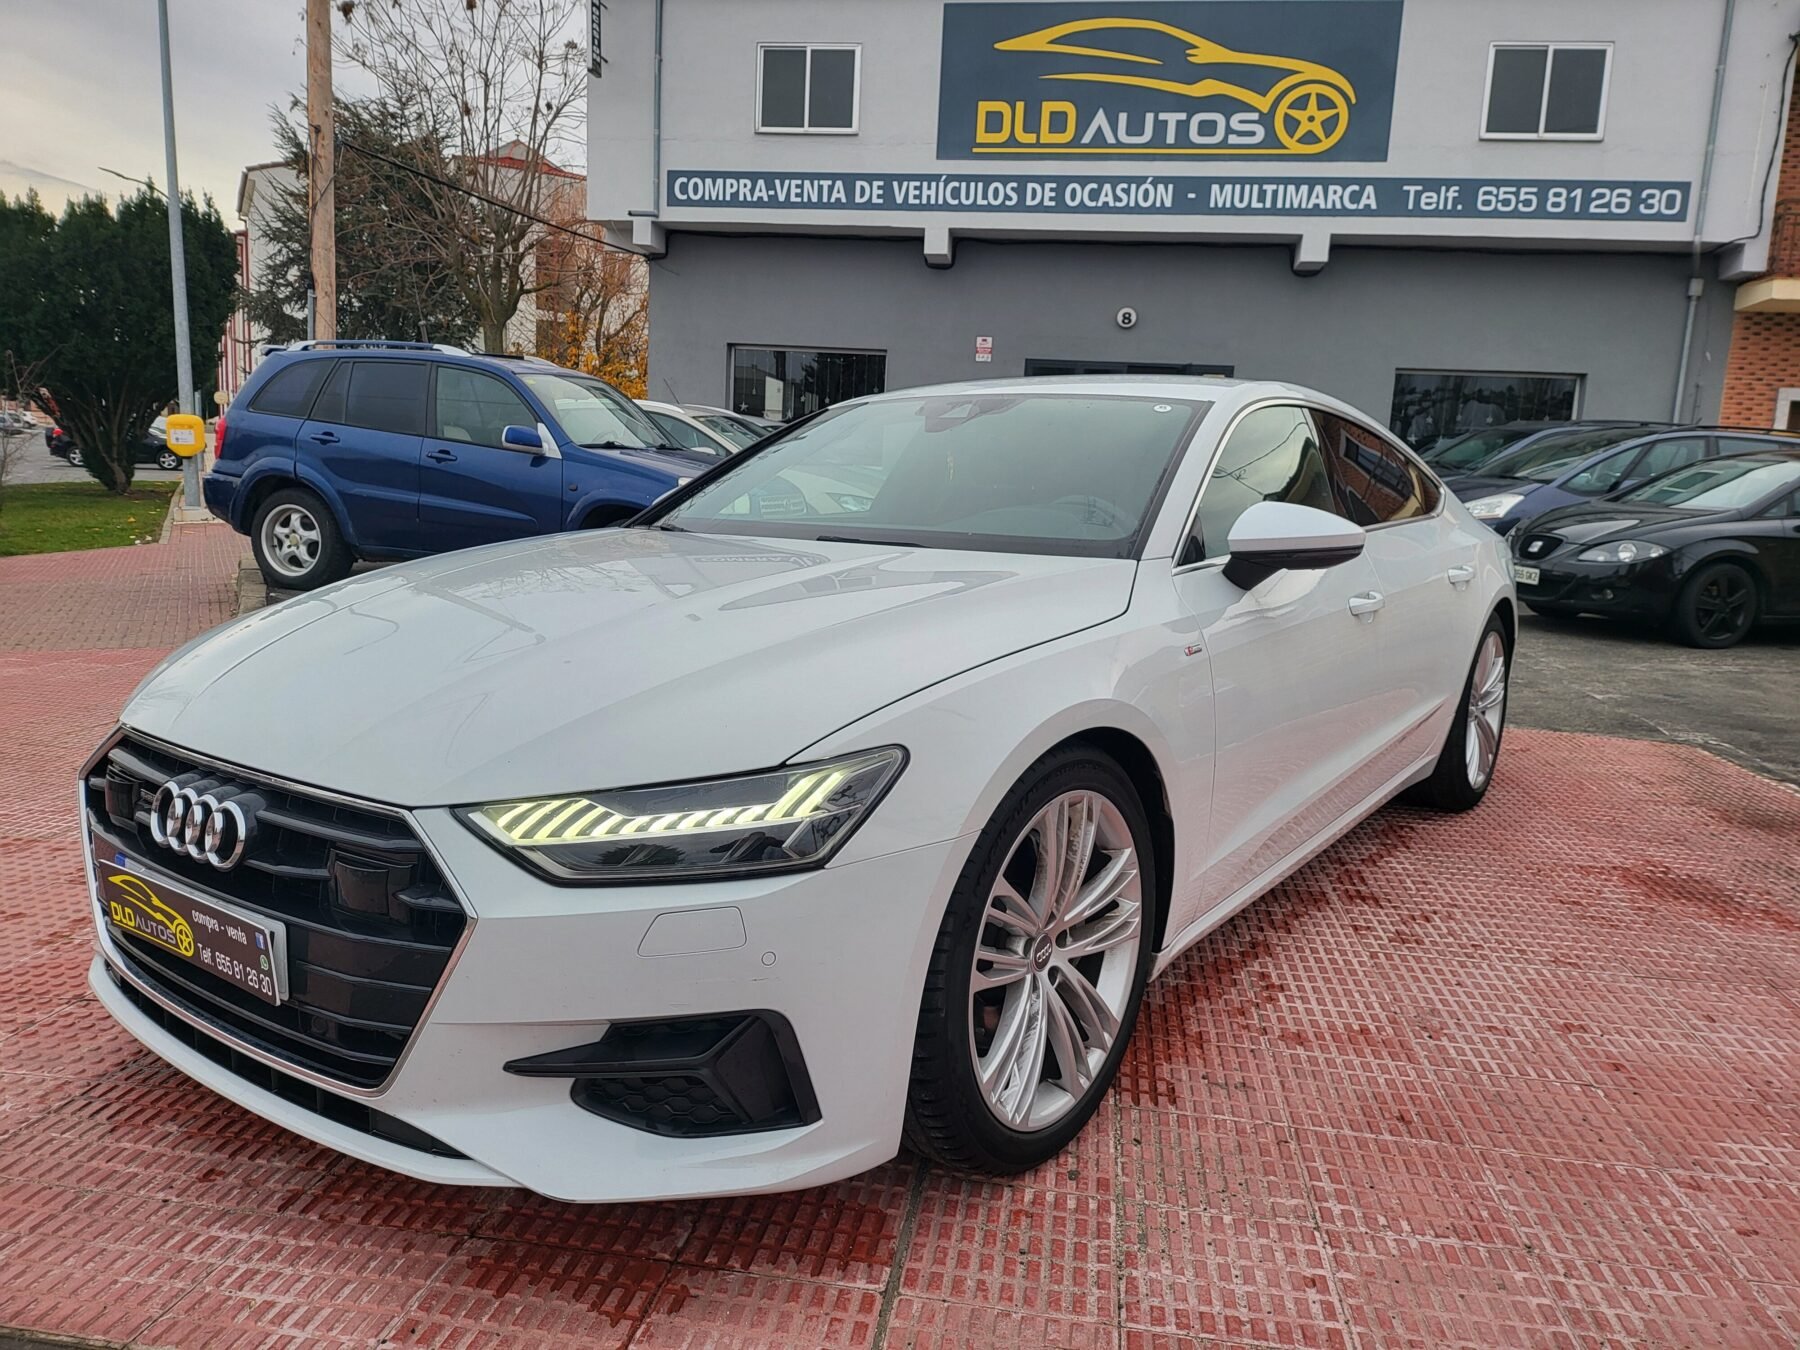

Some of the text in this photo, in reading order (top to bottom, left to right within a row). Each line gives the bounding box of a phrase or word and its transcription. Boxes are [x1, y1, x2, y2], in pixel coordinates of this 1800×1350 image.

[975, 100, 1266, 145] DLD AUTOS
[674, 177, 847, 203] COMPRA-VENTA
[854, 180, 884, 204] DE
[892, 175, 1018, 206] VEHÍCULOS
[1025, 182, 1057, 206] DE
[1064, 177, 1174, 208] OCASIÓN
[1209, 183, 1377, 210] MULTIMARCA
[1402, 185, 1463, 211] Telf.
[1476, 186, 1538, 212] 655
[1639, 188, 1682, 215] 30
[1121, 311, 1132, 325] 8
[110, 901, 176, 944] DLD AUTOS
[191, 910, 219, 933] compra
[225, 925, 247, 945] venta
[197, 943, 273, 996] Telf. 655 81 26 30
